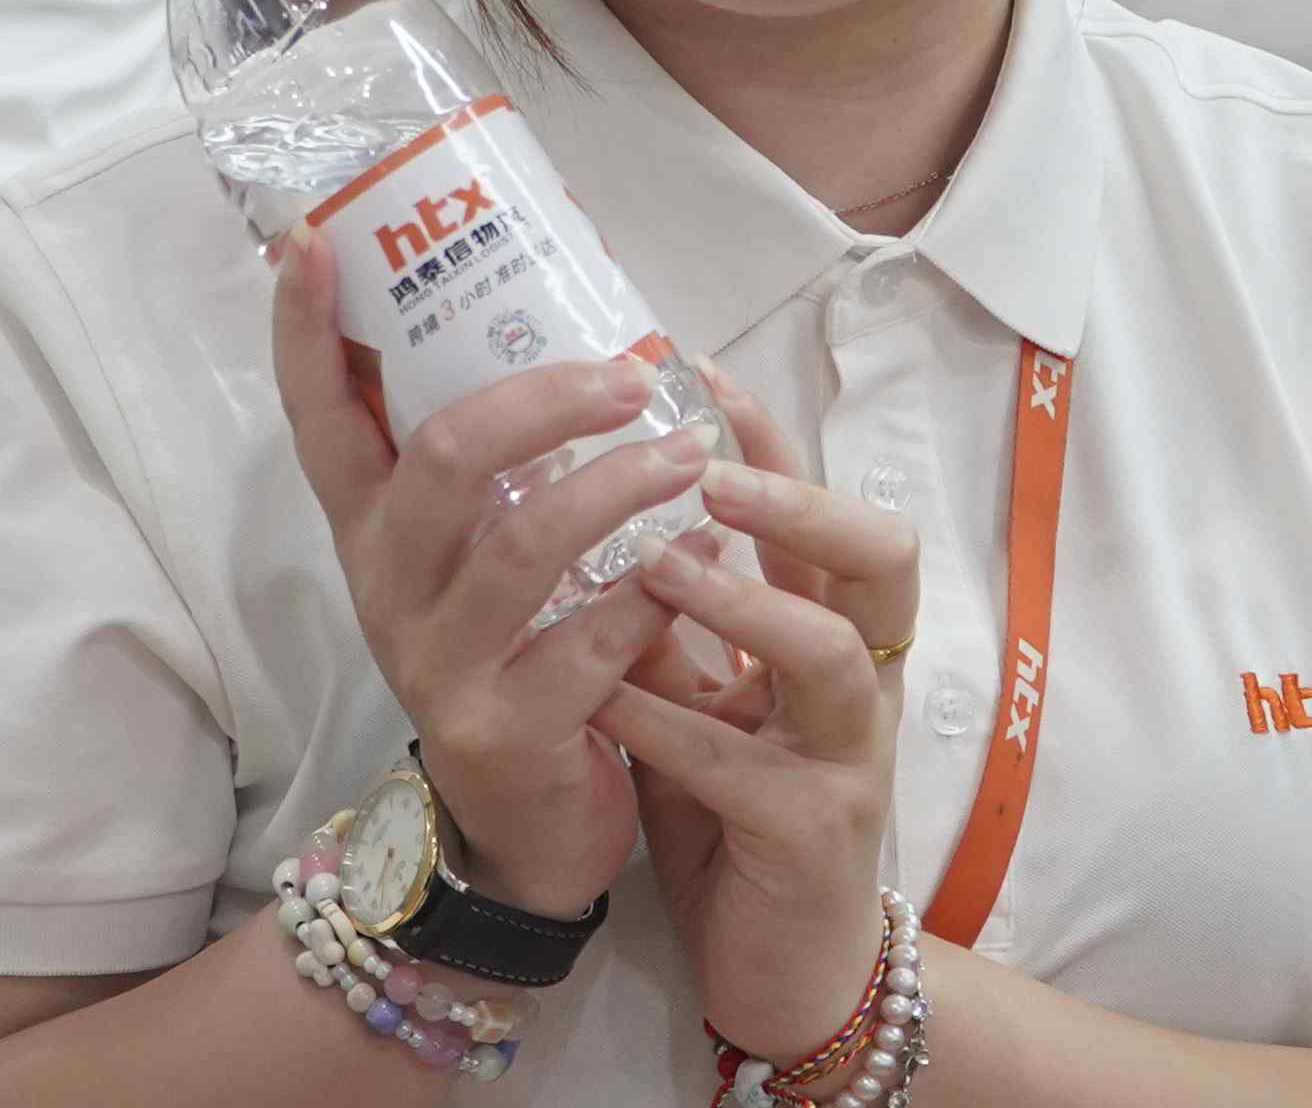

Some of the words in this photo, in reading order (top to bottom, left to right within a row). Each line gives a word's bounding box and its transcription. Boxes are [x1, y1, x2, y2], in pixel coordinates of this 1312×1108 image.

[373, 178, 496, 274] htx
[439, 298, 456, 322] 3
[494, 235, 560, 286] 准时达
[1004, 636, 1044, 754] htx
